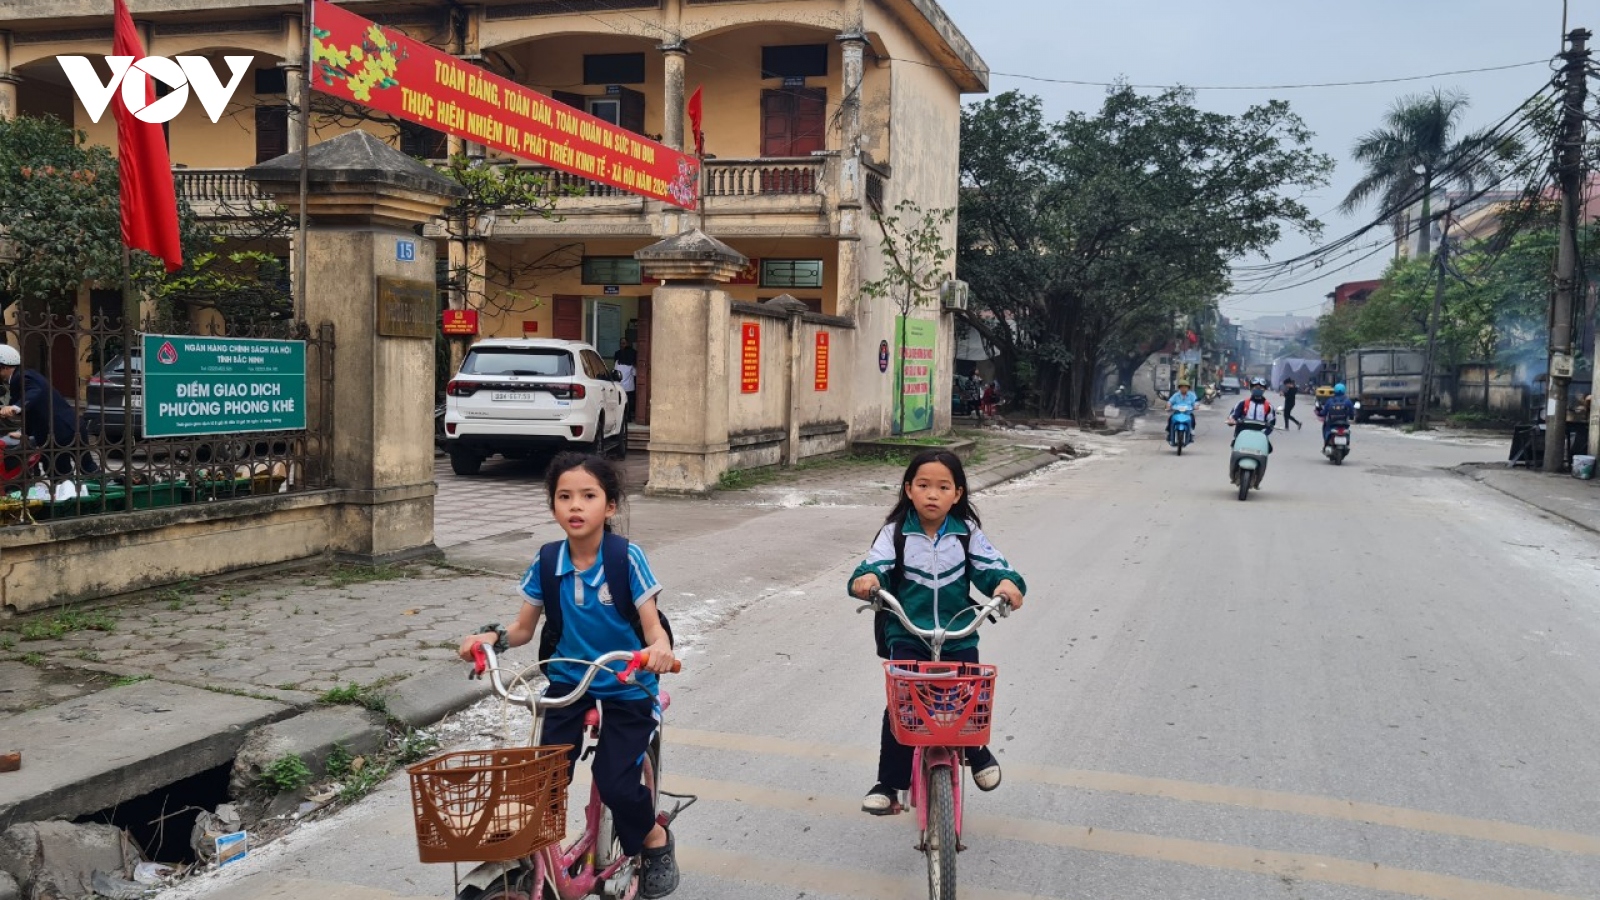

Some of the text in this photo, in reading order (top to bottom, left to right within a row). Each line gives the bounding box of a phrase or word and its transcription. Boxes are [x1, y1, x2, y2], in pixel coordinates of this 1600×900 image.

[435, 60, 655, 165] TOÀN ĐẢNG, TOÀN DÂN, TOÀN QUÂN RA SỨC THI ĐUA
[401, 87, 434, 121] THỰC
[437, 100, 465, 131] HIỆN
[467, 112, 503, 144] NHIỆM
[505, 125, 521, 152] VỤ,
[523, 132, 547, 159] PHÁT
[550, 140, 574, 166] TRIỂN
[575, 150, 595, 176] KINH
[597, 155, 607, 177] TẾ
[611, 162, 622, 182] XÃ
[623, 165, 636, 190] HỘI
[636, 170, 651, 191] NĂM
[400, 243, 412, 258] 15
[176, 380, 281, 398] ĐIỂM GIAO DỊCH
[159, 397, 295, 417] PHƯỜNG PHONG KHÊ
